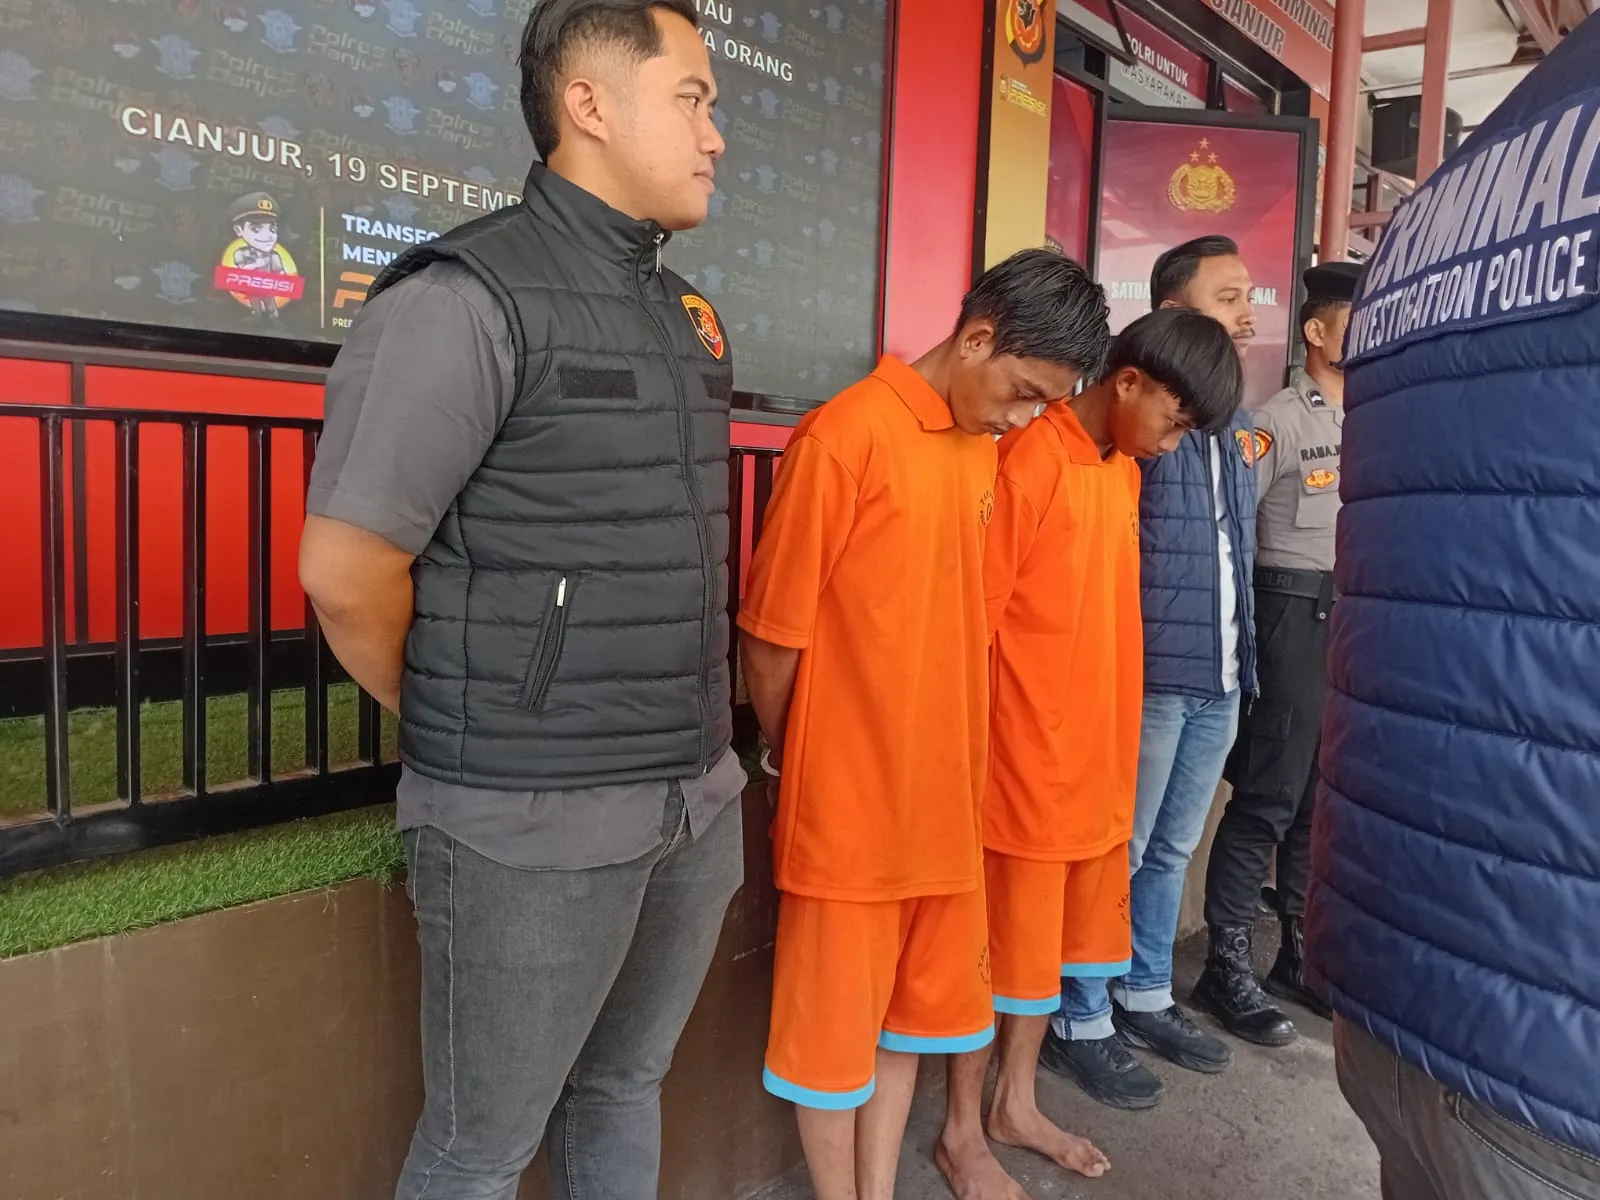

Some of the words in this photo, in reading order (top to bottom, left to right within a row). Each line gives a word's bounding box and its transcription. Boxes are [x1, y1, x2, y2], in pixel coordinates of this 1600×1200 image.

[724, 39, 793, 82] ORANG
[1156, 54, 1189, 88] UNTUK
[121, 106, 313, 177] CIANJUR,
[328, 152, 367, 183] 19
[1361, 104, 1600, 299] CRIMINAL
[343, 243, 398, 266] MEN
[226, 272, 296, 293] PRESISI
[1346, 259, 1482, 360] INVESTIGATION
[1481, 229, 1592, 316] POLICE
